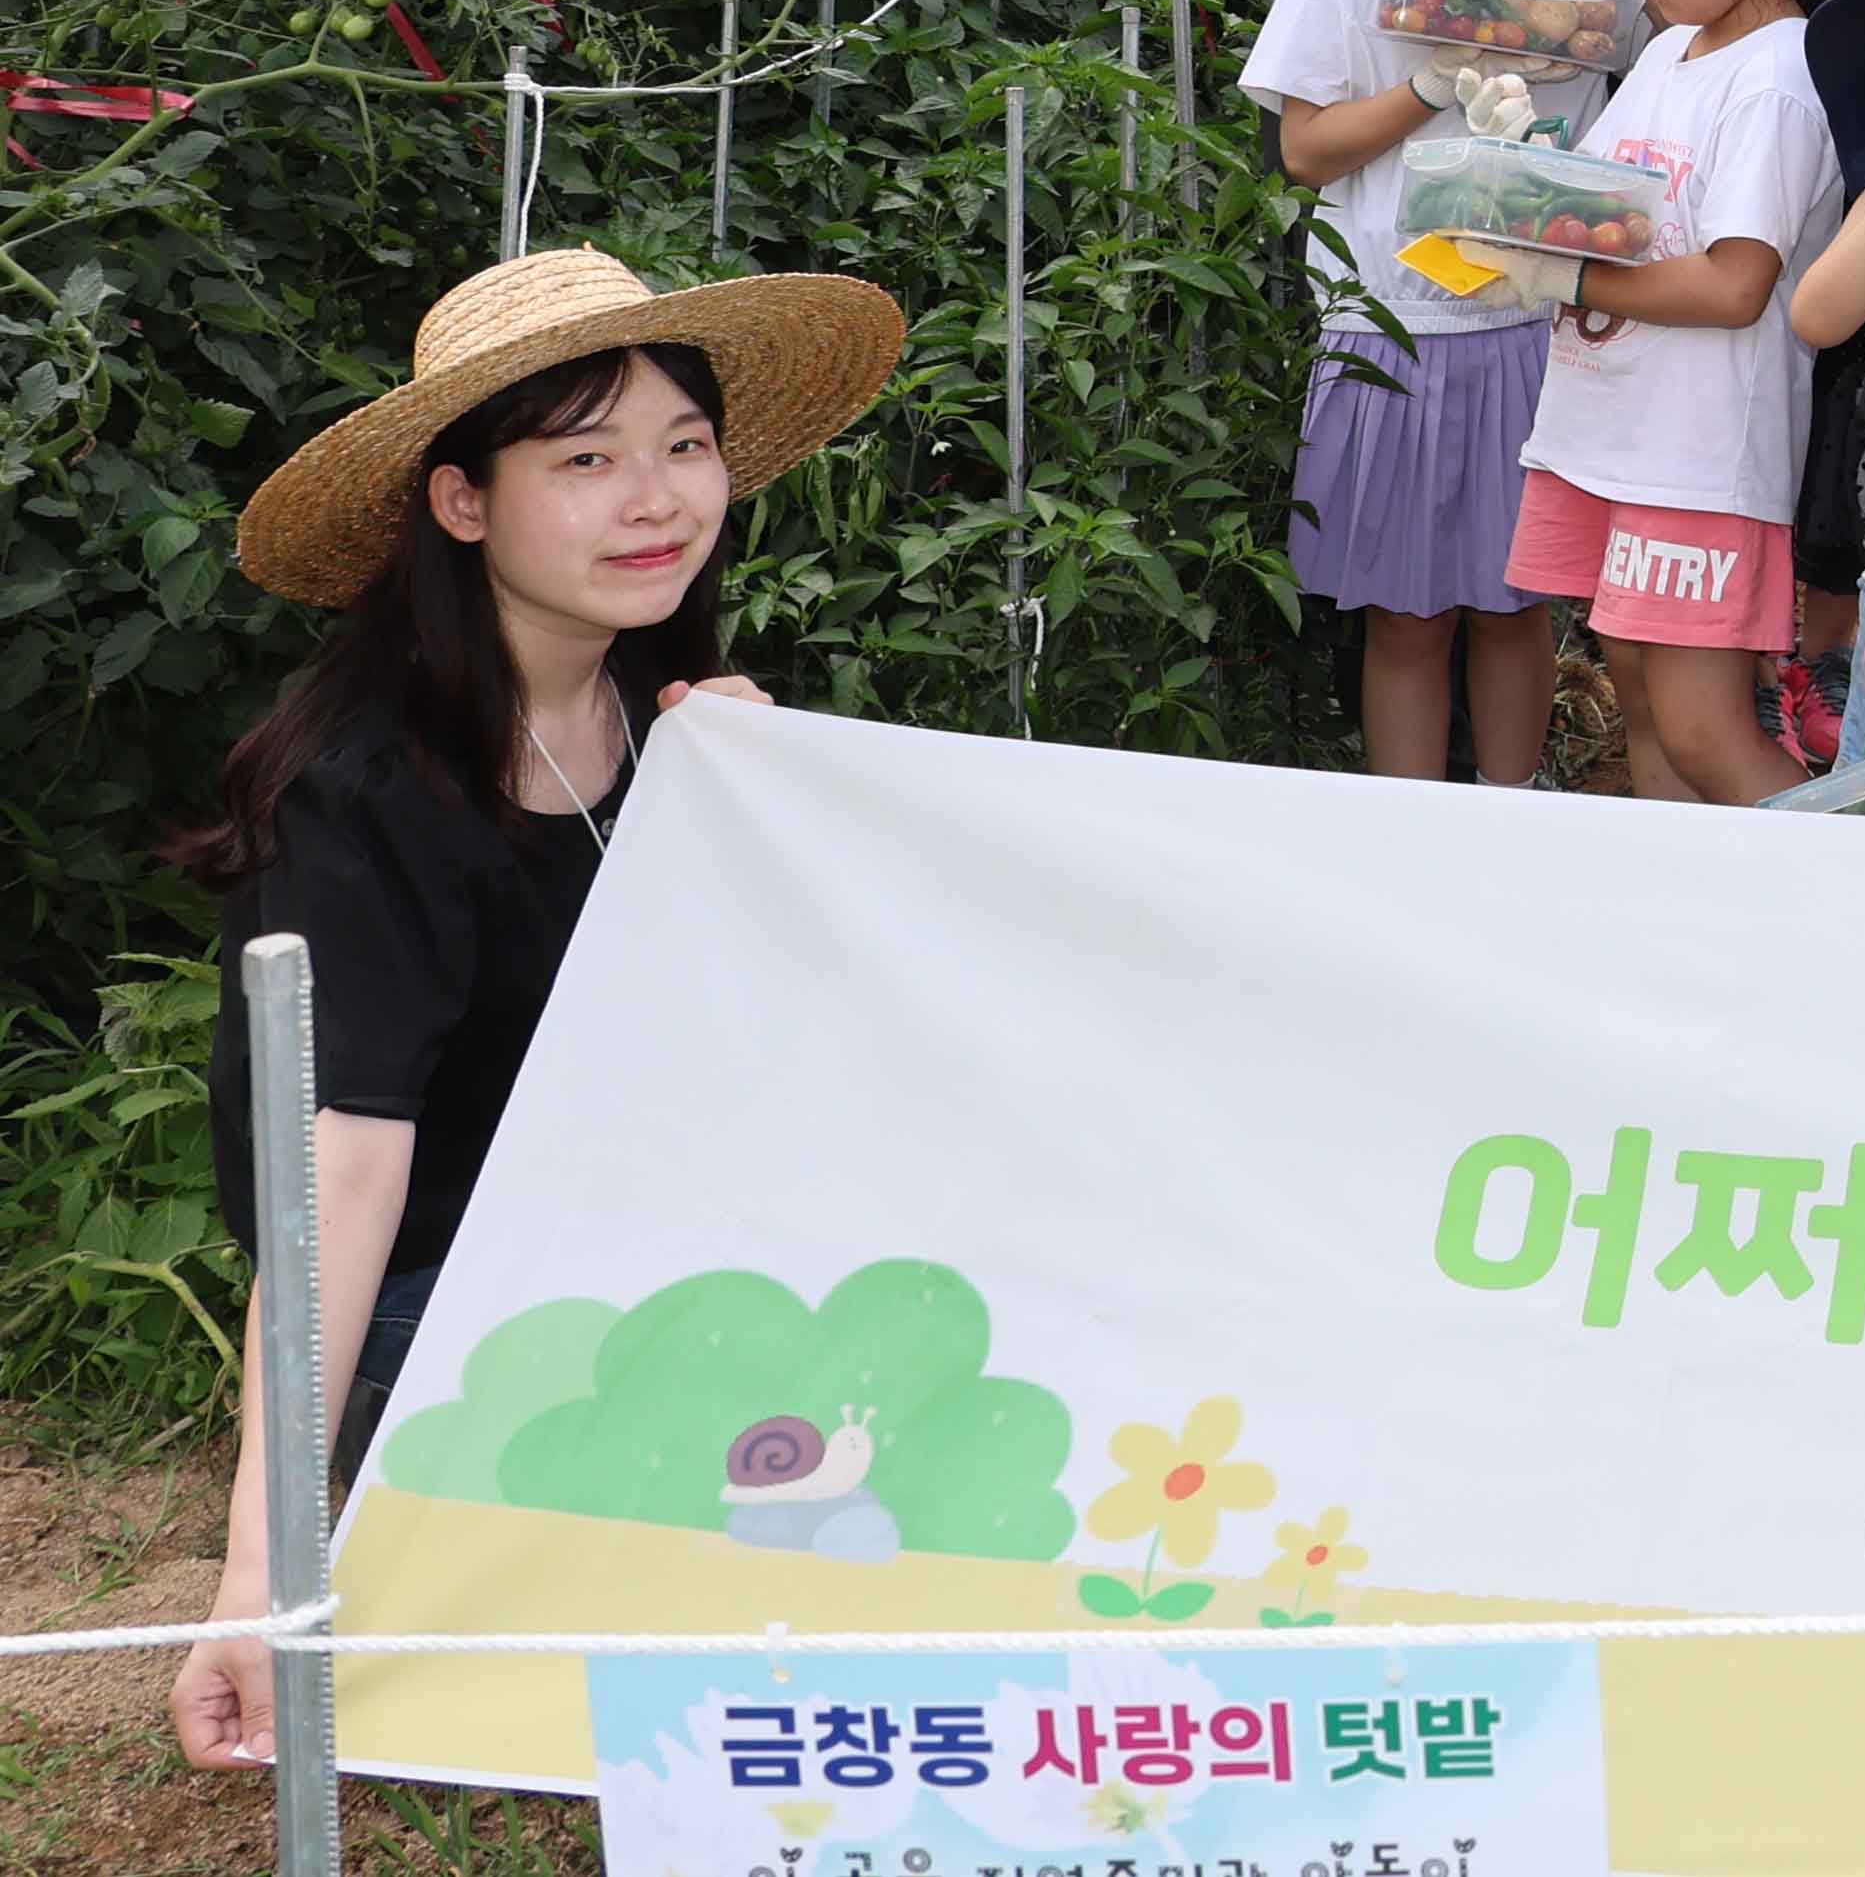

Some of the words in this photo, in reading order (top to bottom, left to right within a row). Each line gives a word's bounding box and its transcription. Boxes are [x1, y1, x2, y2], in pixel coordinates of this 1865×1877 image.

[722, 1705, 994, 1788] 금창동
[1023, 1703, 1291, 1787] 사랑의
[1323, 1698, 1500, 1782] 텃밭
